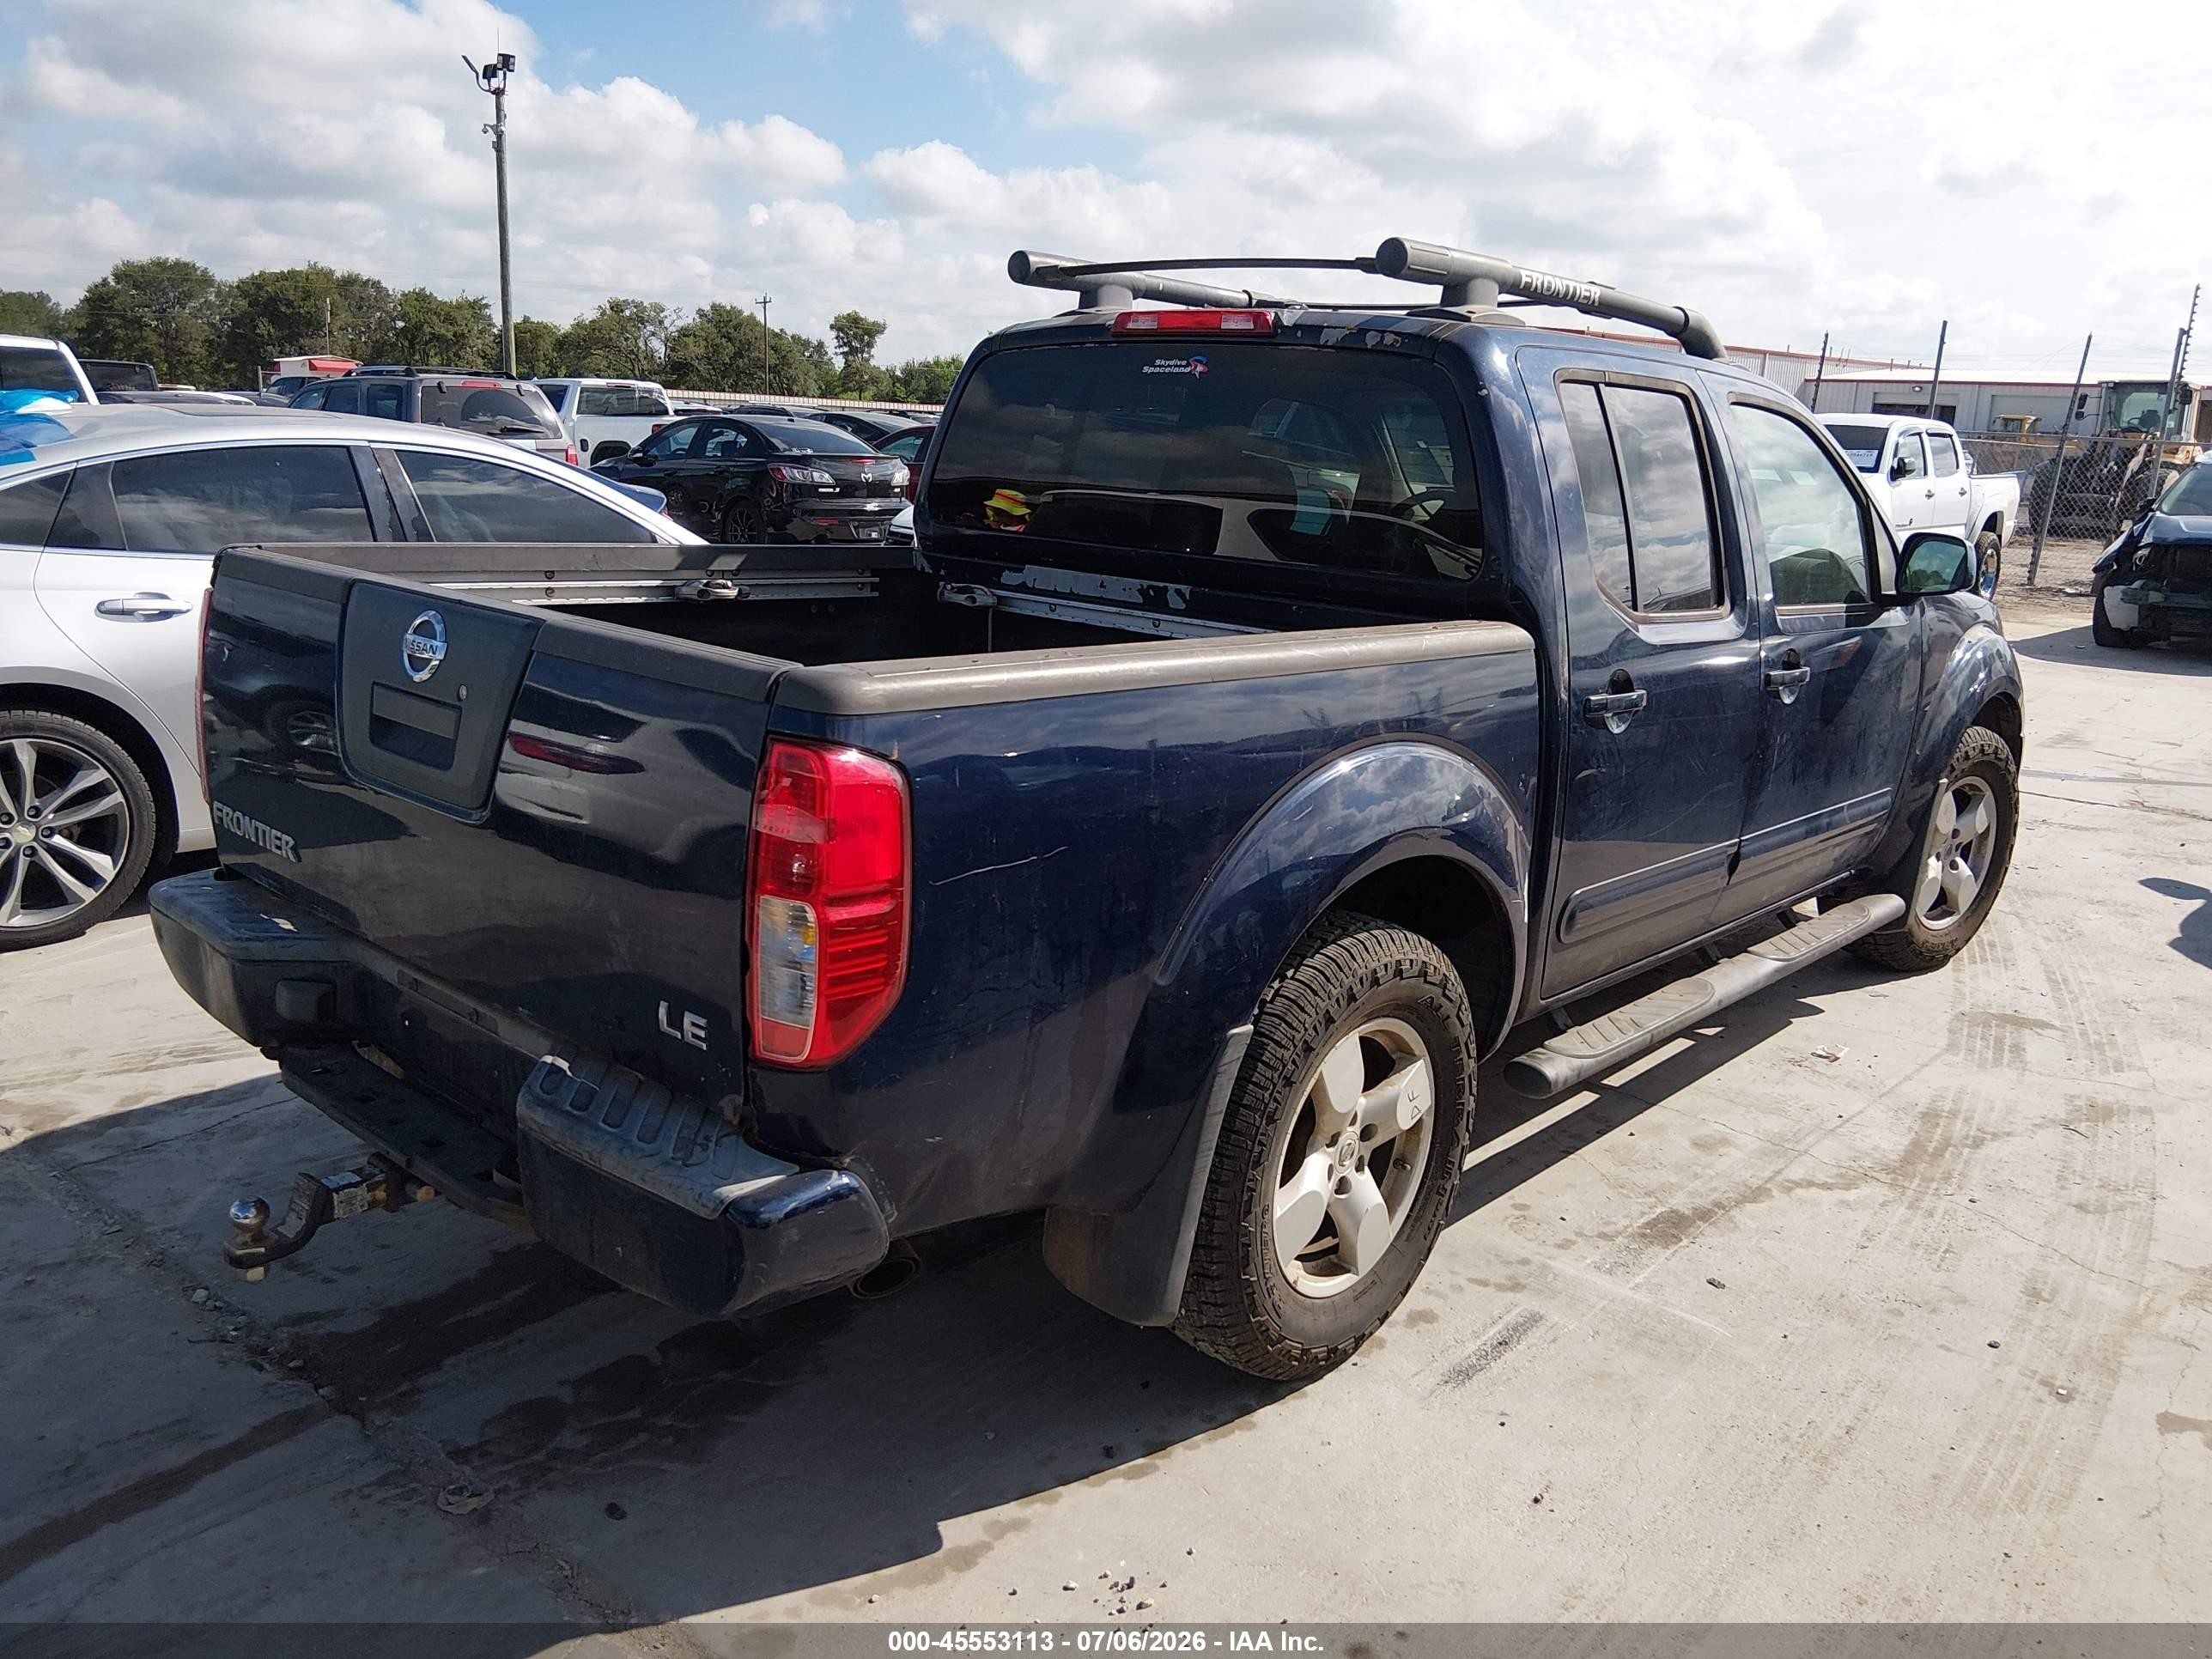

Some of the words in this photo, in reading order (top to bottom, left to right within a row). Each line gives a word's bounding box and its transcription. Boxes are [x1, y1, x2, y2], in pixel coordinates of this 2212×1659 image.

[1519, 270, 1601, 306] FRONTIER
[213, 800, 296, 863] FRONTIER
[659, 1000, 708, 1050] LE
[1418, 995, 1450, 1030] ALL
